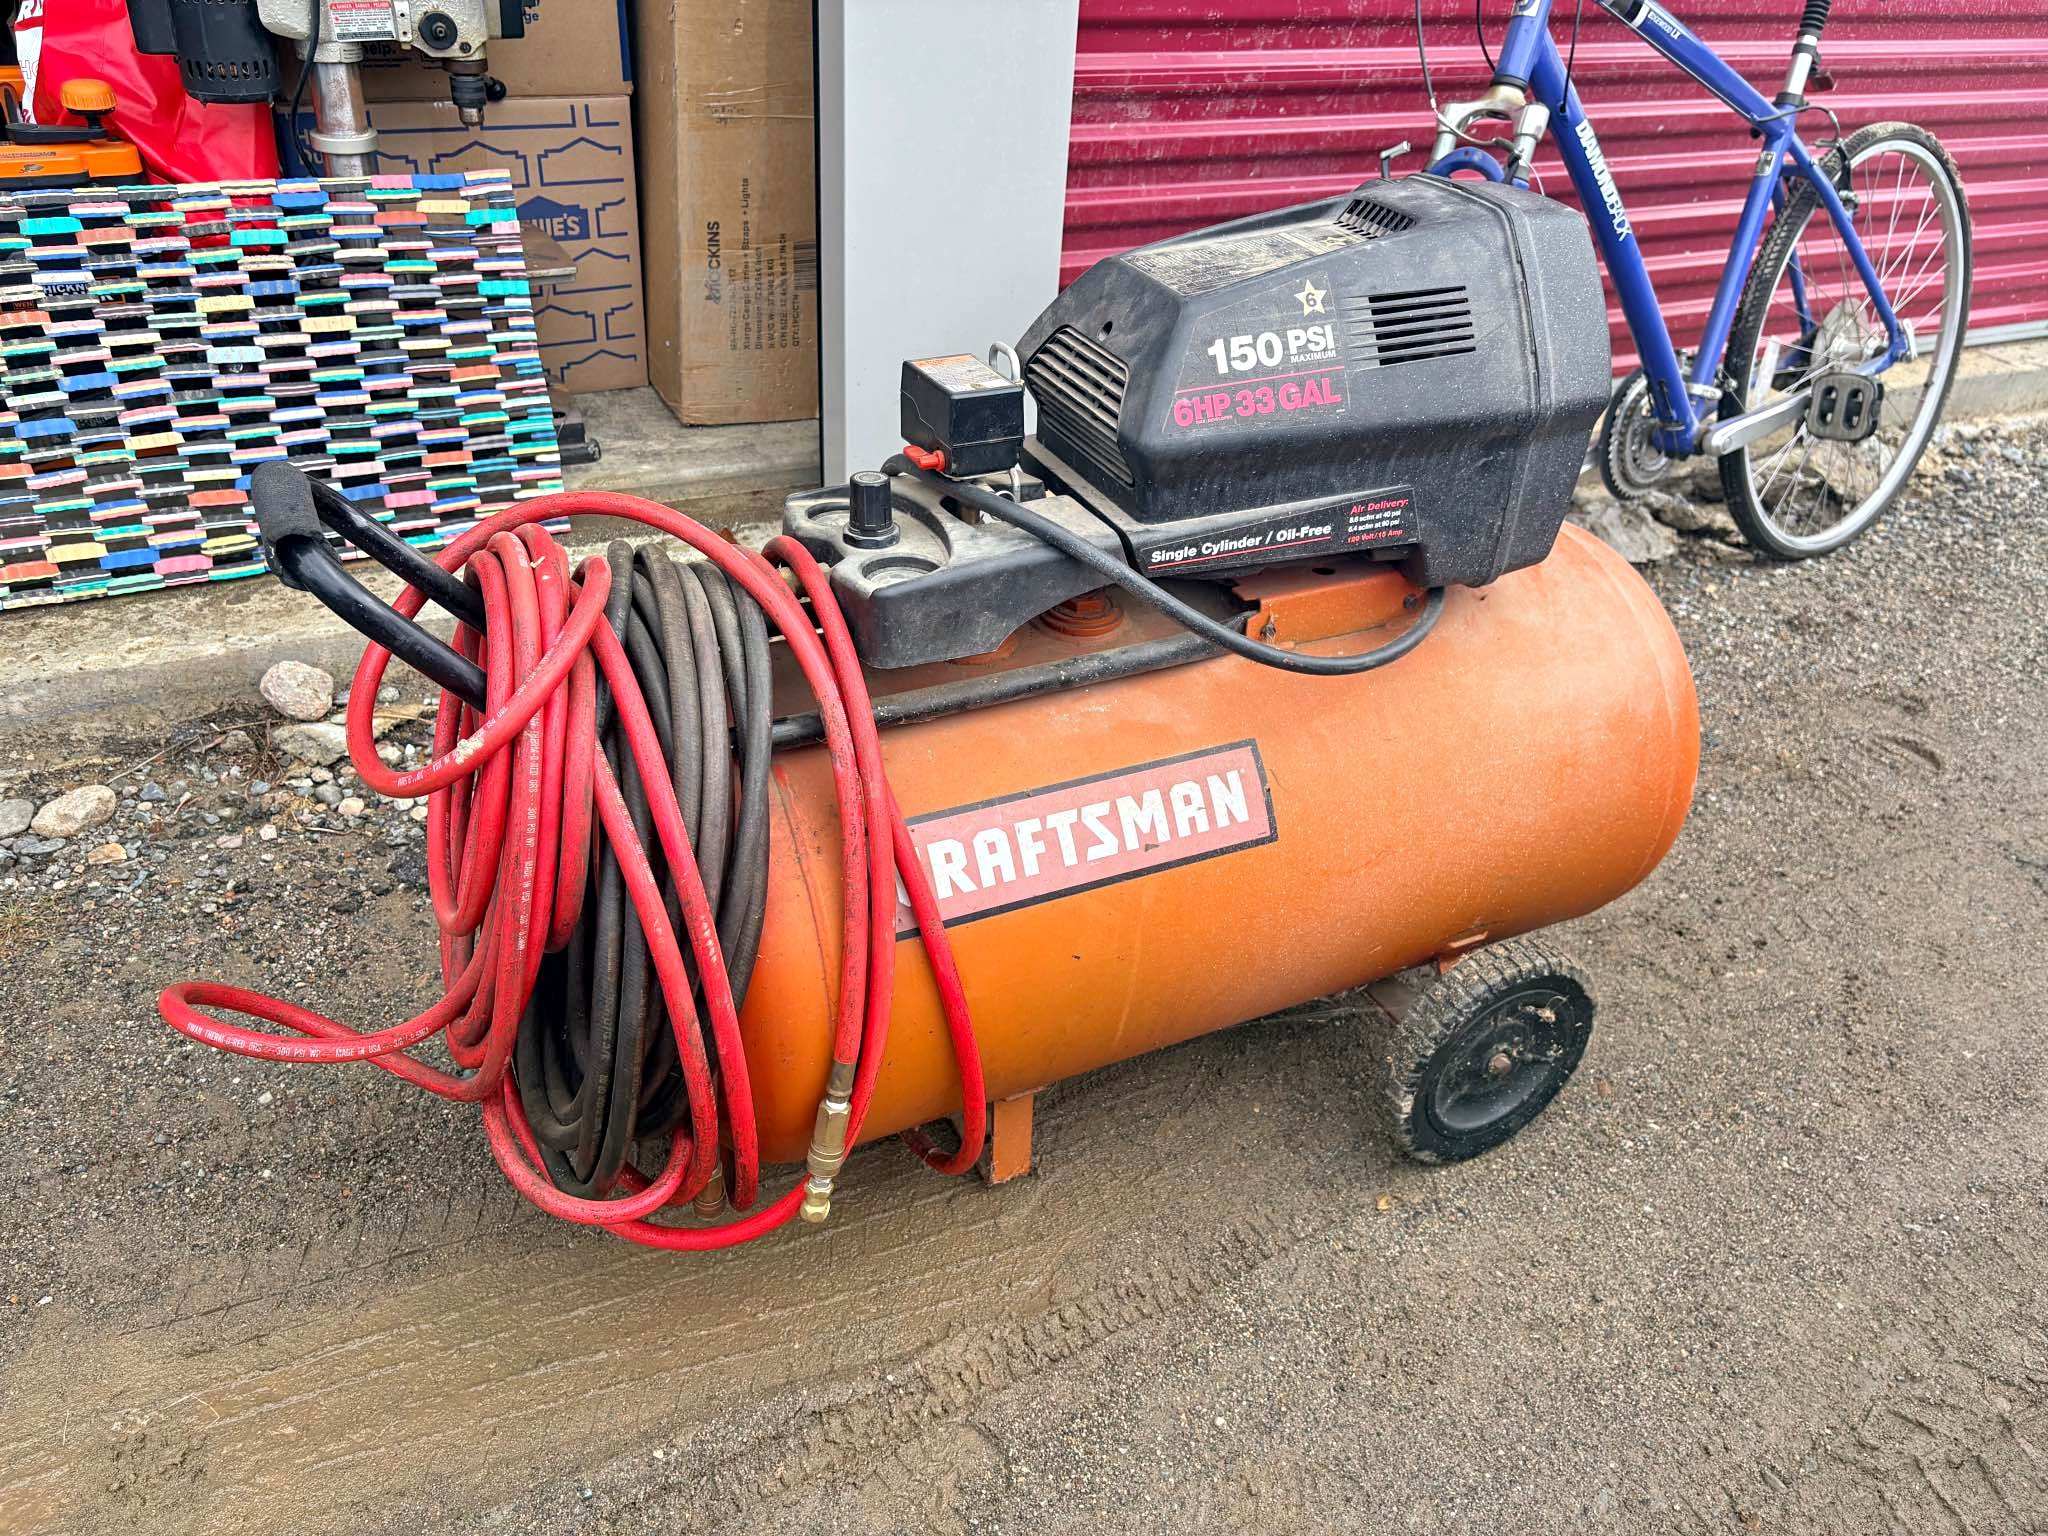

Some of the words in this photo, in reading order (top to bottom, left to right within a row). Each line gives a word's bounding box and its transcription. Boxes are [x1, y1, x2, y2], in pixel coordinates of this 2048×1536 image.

[1575, 119, 1631, 241] DIAMONDBACK
[740, 178, 750, 208] Lights
[1305, 292, 1317, 308] 6
[1207, 331, 1283, 375] 150
[1286, 324, 1336, 354] PSI
[1290, 349, 1337, 363] MAXIMUM
[1173, 392, 1232, 427] 6HP
[1235, 386, 1276, 417] 33
[1278, 377, 1342, 411] GAL
[1350, 504, 1365, 515] Air
[1368, 498, 1409, 511] Delivery:
[1383, 510, 1391, 518] 40
[1391, 509, 1402, 518] psi
[1390, 518, 1400, 527] psi
[1388, 529, 1403, 538] Amp
[1151, 545, 1197, 563] Single
[1201, 534, 1262, 558] Cylinder
[1276, 524, 1332, 542] Oil-Free
[905, 768, 1251, 906] RAFTSMAN
[276, 1046, 291, 1057] 300
[294, 1047, 306, 1058] PSI
[335, 1047, 354, 1057] MADE
[368, 1043, 382, 1054] USA
